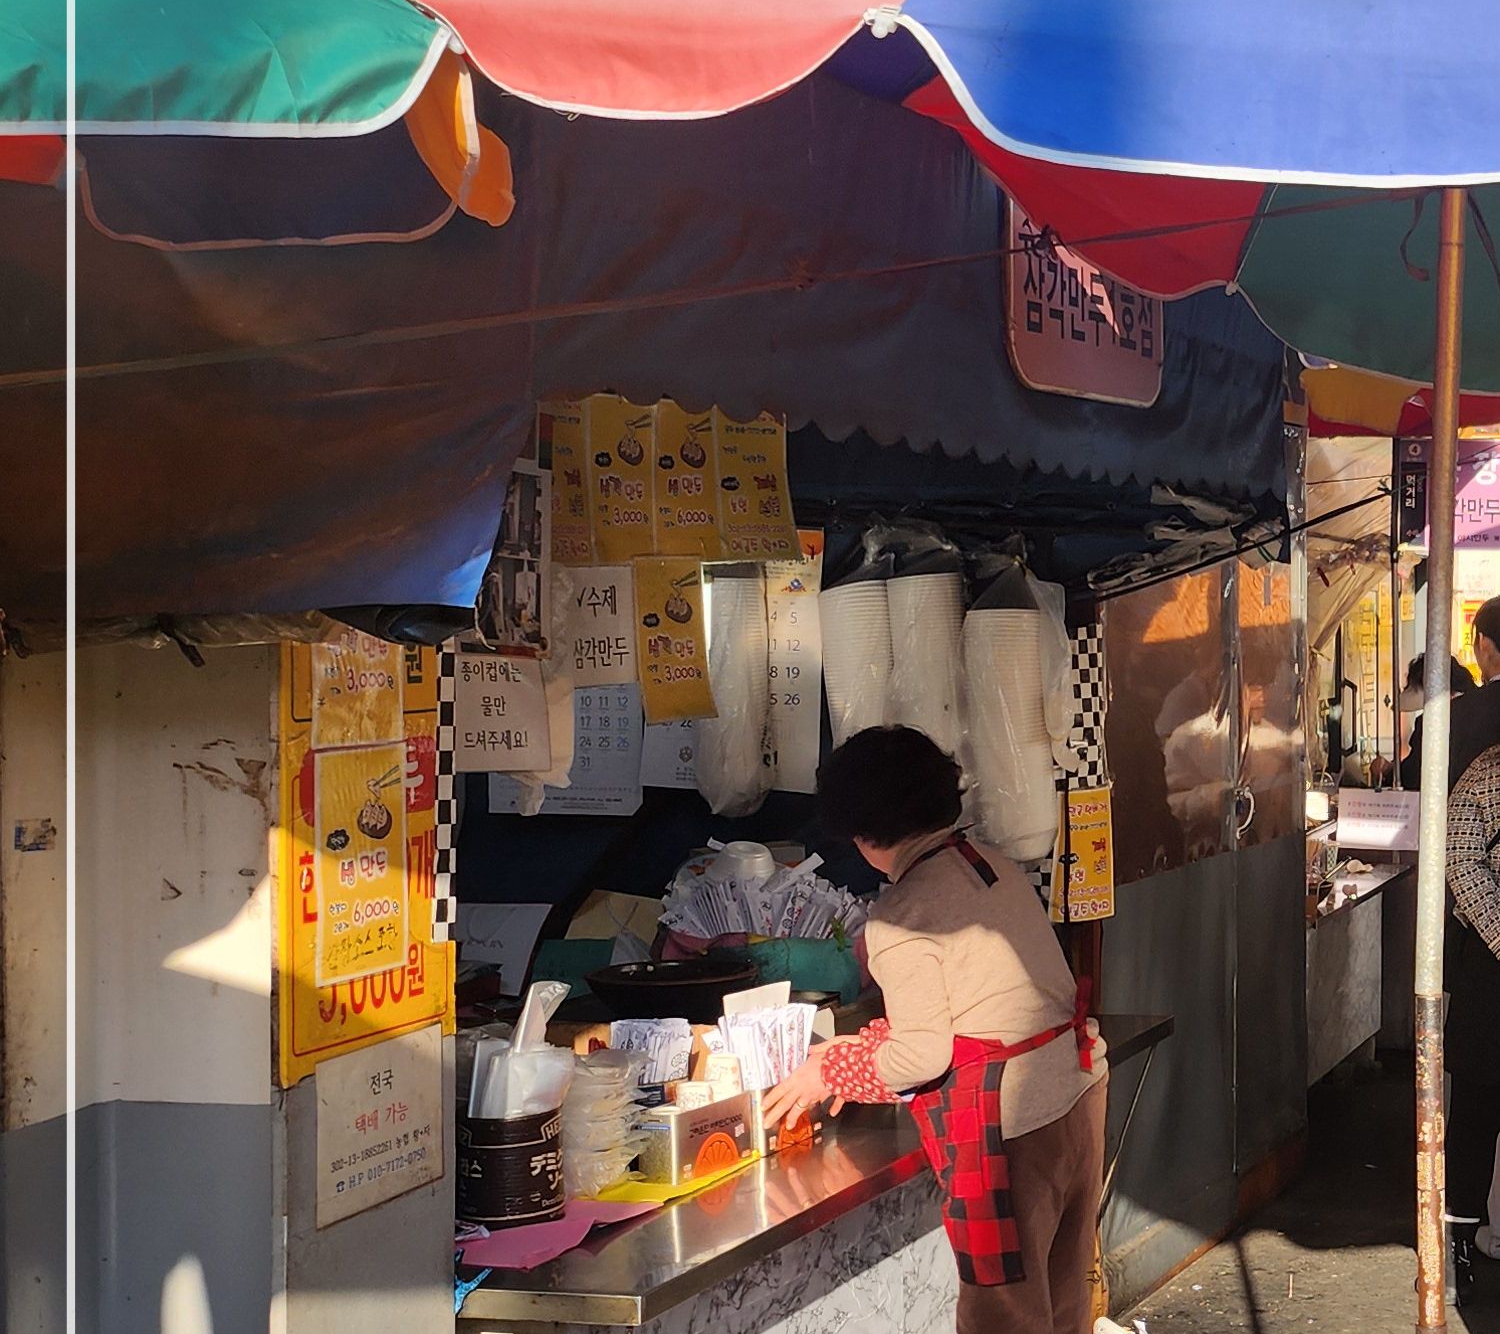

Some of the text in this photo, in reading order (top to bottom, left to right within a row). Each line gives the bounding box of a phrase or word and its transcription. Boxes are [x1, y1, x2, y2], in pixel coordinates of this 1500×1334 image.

[1455, 498, 1500, 524] 각만두
[587, 585, 617, 617] 수제
[573, 637, 630, 669] 삼각만두
[786, 638, 800, 652] 12
[461, 661, 522, 683] 종이컵에는
[786, 666, 800, 679] 19
[480, 695, 506, 717] 물만
[580, 696, 629, 708] 10 11 12
[784, 693, 800, 706] 26
[580, 716, 629, 728] 17 18 19
[464, 730, 529, 752] 드셔주세요!
[579, 736, 629, 748] 24 25 26
[580, 756, 590, 767] 31
[370, 1069, 394, 1095] 전국
[355, 1102, 409, 1136] 택배 가능
